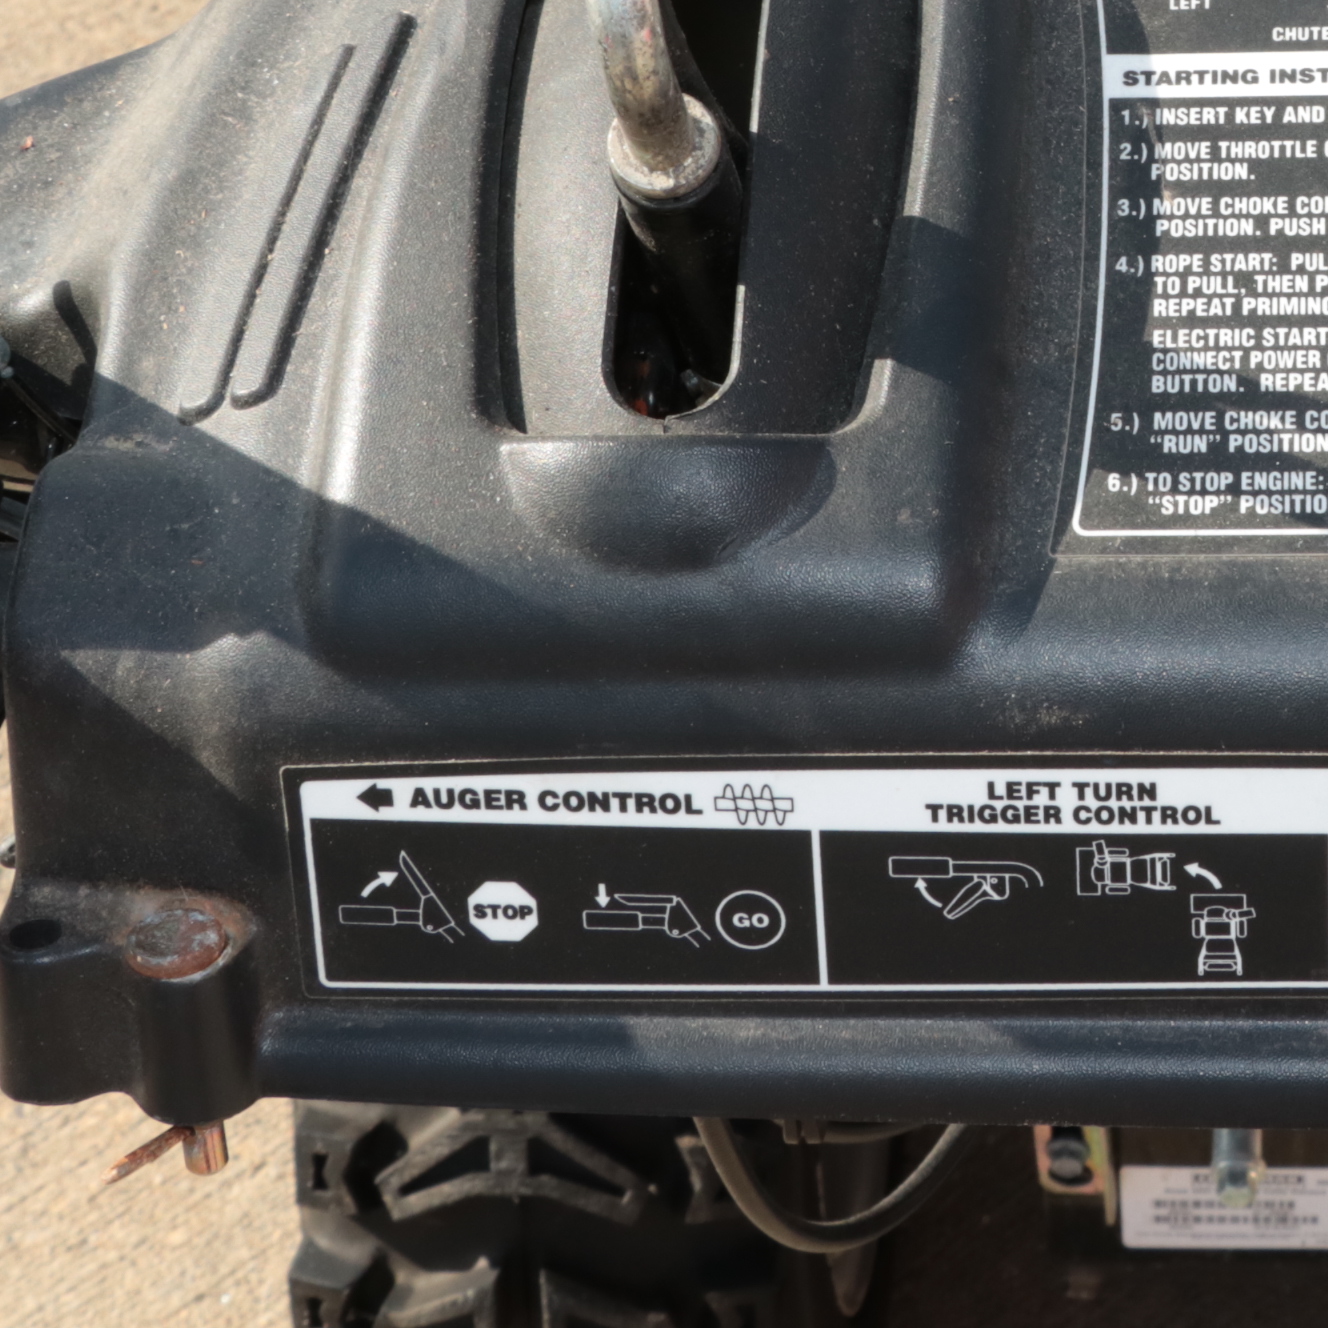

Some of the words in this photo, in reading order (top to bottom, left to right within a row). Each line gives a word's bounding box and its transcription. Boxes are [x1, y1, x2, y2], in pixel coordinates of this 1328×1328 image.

[1123, 69, 1259, 86] STARTING
[1122, 107, 1150, 128] 1.)
[1156, 107, 1228, 125] INSERT
[1236, 107, 1275, 124] KEY
[1283, 106, 1325, 123] AND
[1120, 143, 1147, 163] 2.)
[1155, 142, 1210, 159] MOVE
[1218, 140, 1317, 159] THROTTLE
[1151, 162, 1255, 181] POSITION.
[1117, 199, 1145, 219] 3.)
[1153, 197, 1212, 215] MOVE
[1220, 197, 1288, 215] CHOKE
[1156, 218, 1261, 237] POSITION.
[1270, 218, 1325, 236] PUSH
[1115, 256, 1144, 277] 4.)
[1152, 254, 1203, 273] ROPE
[1210, 253, 1277, 272] START:
[1154, 276, 1180, 295] TO
[1188, 276, 1245, 296] PULL,
[1254, 275, 1308, 293] THEN
[1153, 298, 1235, 317] REPEAT
[1153, 328, 1255, 348] ELECTRIC
[1152, 351, 1243, 371] CONNECT
[1250, 350, 1320, 369] POWER
[1152, 372, 1247, 393] BUTTON.
[1111, 413, 1139, 434] 5.)
[1154, 412, 1216, 430] MOVE
[1225, 411, 1296, 430] CHOKE
[1107, 473, 1138, 495] 6.)
[1145, 472, 1171, 492] TO
[1179, 472, 1233, 491] STOP
[1241, 471, 1323, 490] ENGINE:
[410, 788, 527, 810] AUGER
[538, 790, 703, 815] CONTROL
[988, 781, 1061, 801] LEFT
[1072, 782, 1156, 802] TURN
[925, 804, 1062, 824] TRIGGER
[1073, 805, 1221, 825] CONTROL
[473, 904, 533, 920] STOP
[733, 913, 769, 927] GO
